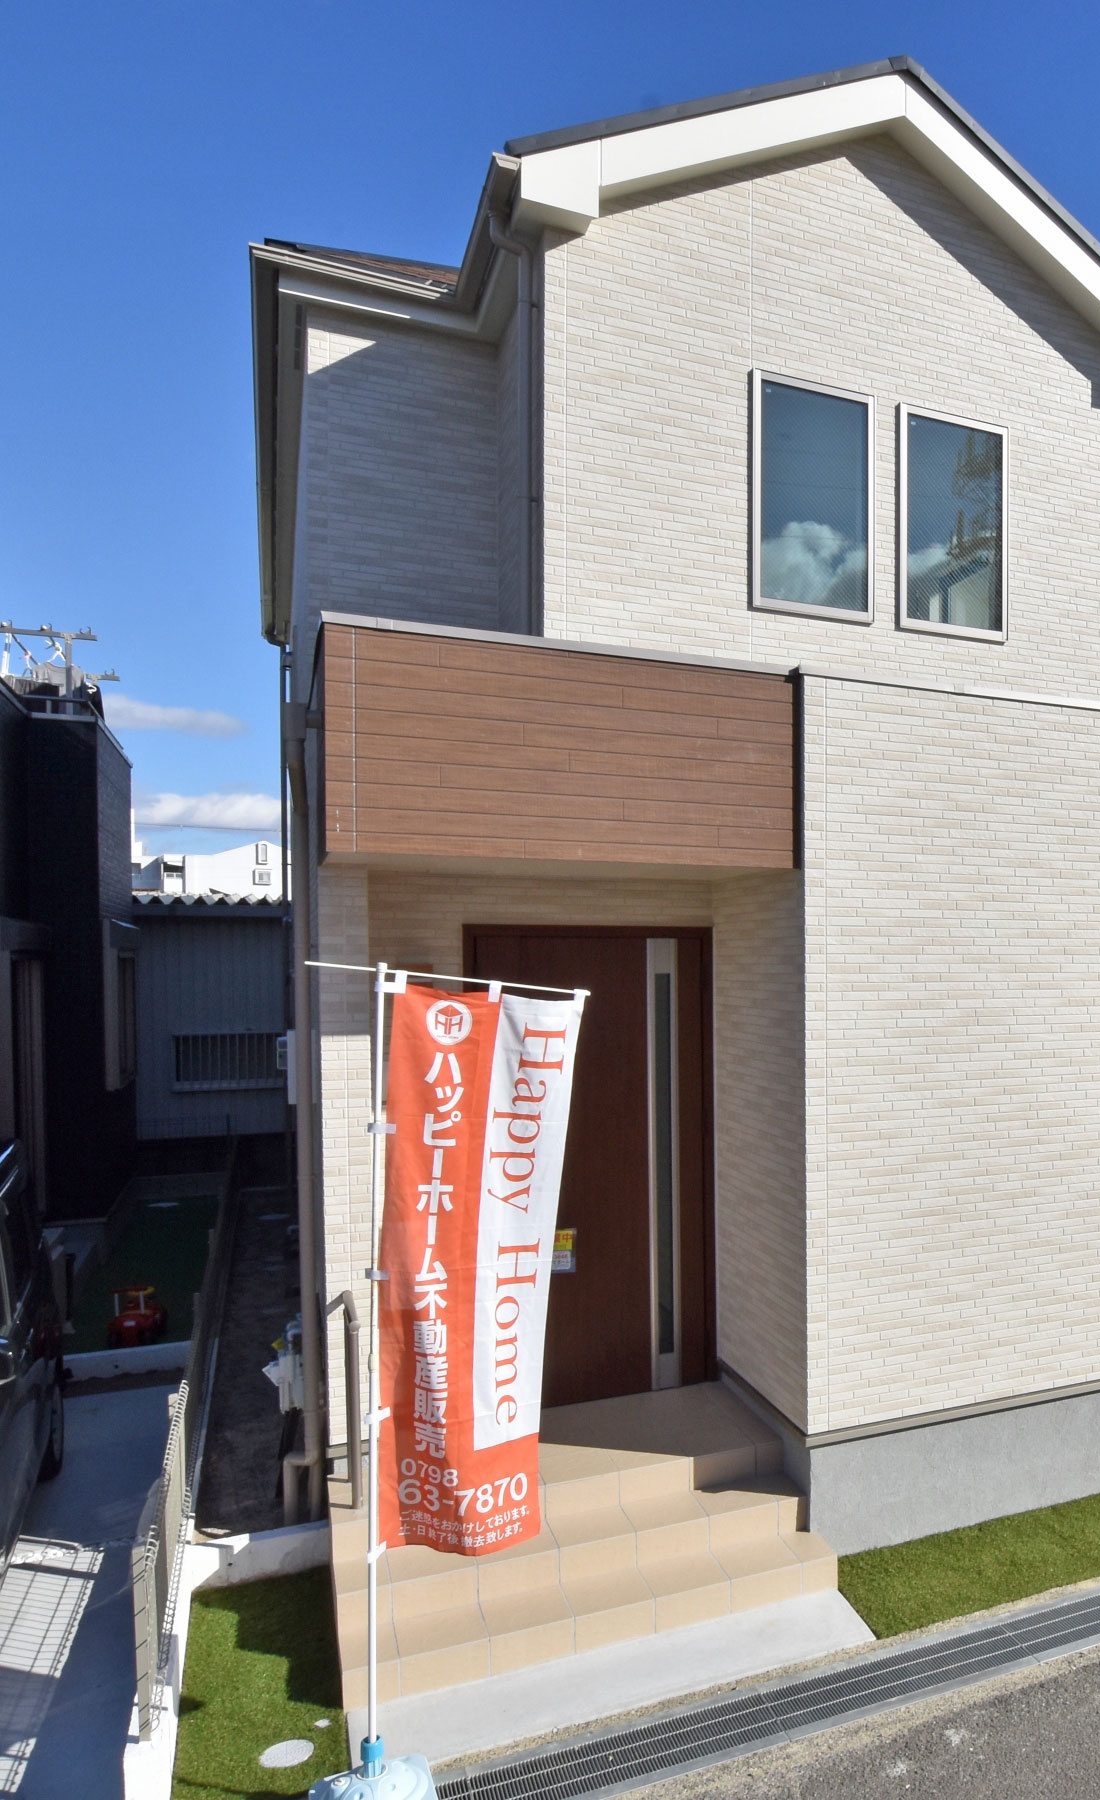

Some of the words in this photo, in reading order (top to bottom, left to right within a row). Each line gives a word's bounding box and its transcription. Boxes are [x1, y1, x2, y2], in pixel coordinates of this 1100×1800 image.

[488, 1022, 568, 1214] Happy
[413, 1052, 465, 1459] ハッピーホーム不動産販売
[494, 1237, 541, 1426] Home
[399, 1472, 528, 1517] 63-7870
[400, 1458, 459, 1487] 0798
